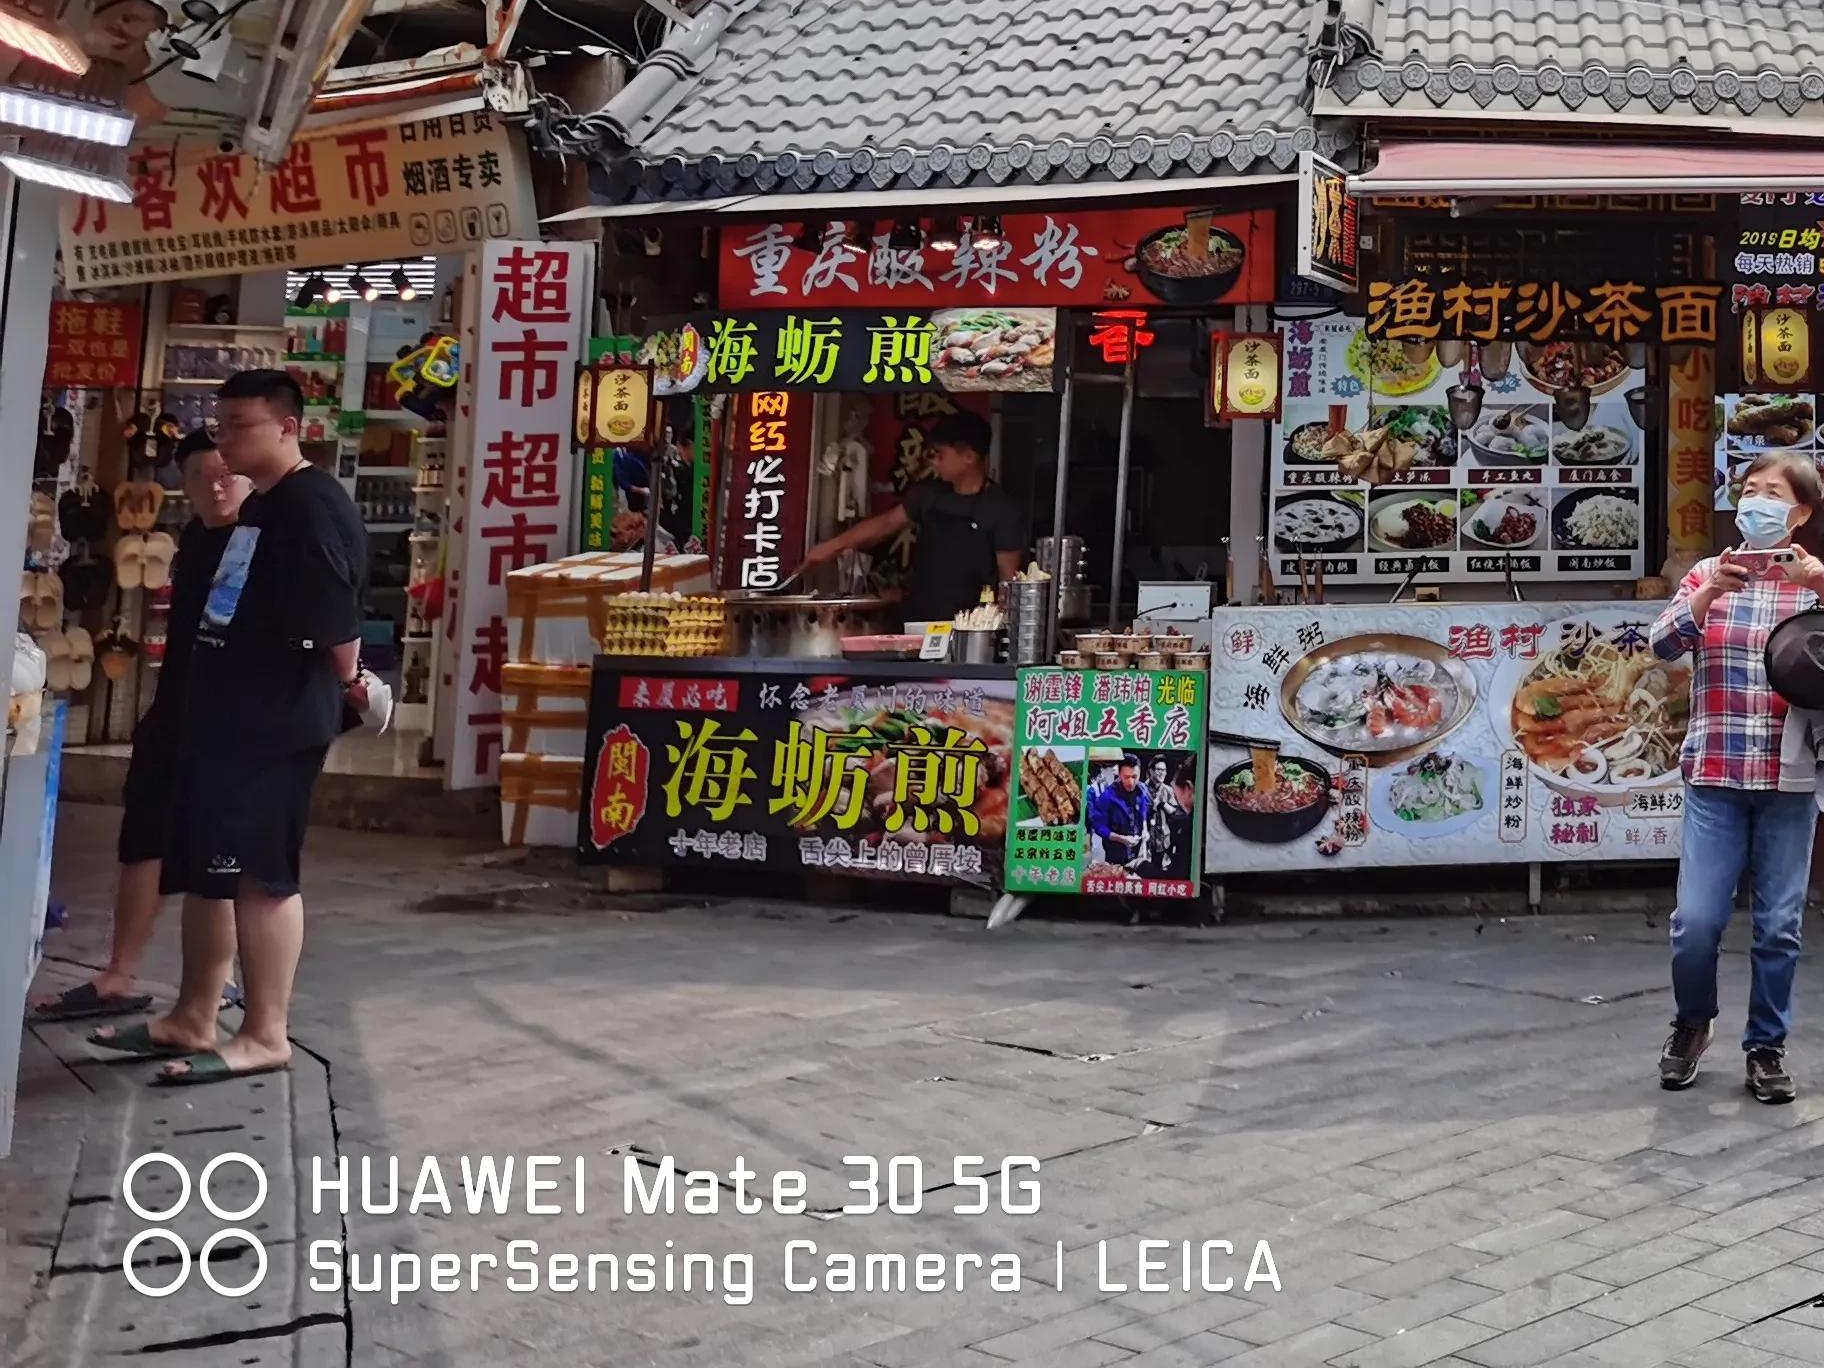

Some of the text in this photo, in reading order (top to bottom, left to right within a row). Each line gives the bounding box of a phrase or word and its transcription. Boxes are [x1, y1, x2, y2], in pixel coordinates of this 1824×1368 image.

[403, 149, 503, 196] 烟酒专卖
[733, 215, 1098, 296] 重庆酸辣粉
[1735, 252, 1814, 275] 每天热销
[1367, 281, 1720, 342] 渔村沙茶面
[707, 315, 939, 386] 海蛎煎
[1776, 313, 1793, 353] 沙茶面
[1245, 341, 1262, 380] 沙茶面
[613, 373, 631, 411] 沙茶面
[1675, 348, 1711, 540] 小吃美食
[741, 392, 788, 590] 网红必打卡店
[1482, 470, 1535, 482] 手工鱼丸
[1568, 556, 1617, 570] 闽南炒饭
[1229, 628, 1255, 654] 鲜
[632, 680, 988, 716] 来厦必吃 怀念老厦门的味道
[1024, 673, 1196, 706] 谢霆锋 潘玮柏 光临
[1026, 705, 1192, 749] 阿姐五香店
[662, 718, 988, 837] 海蛎煎
[1504, 757, 1524, 829] 海鲜炒粉
[1551, 796, 1600, 818] 独家
[669, 829, 982, 875] 十年老店 舌尖上的曾厝垵
[1550, 822, 1599, 845] 秘制
